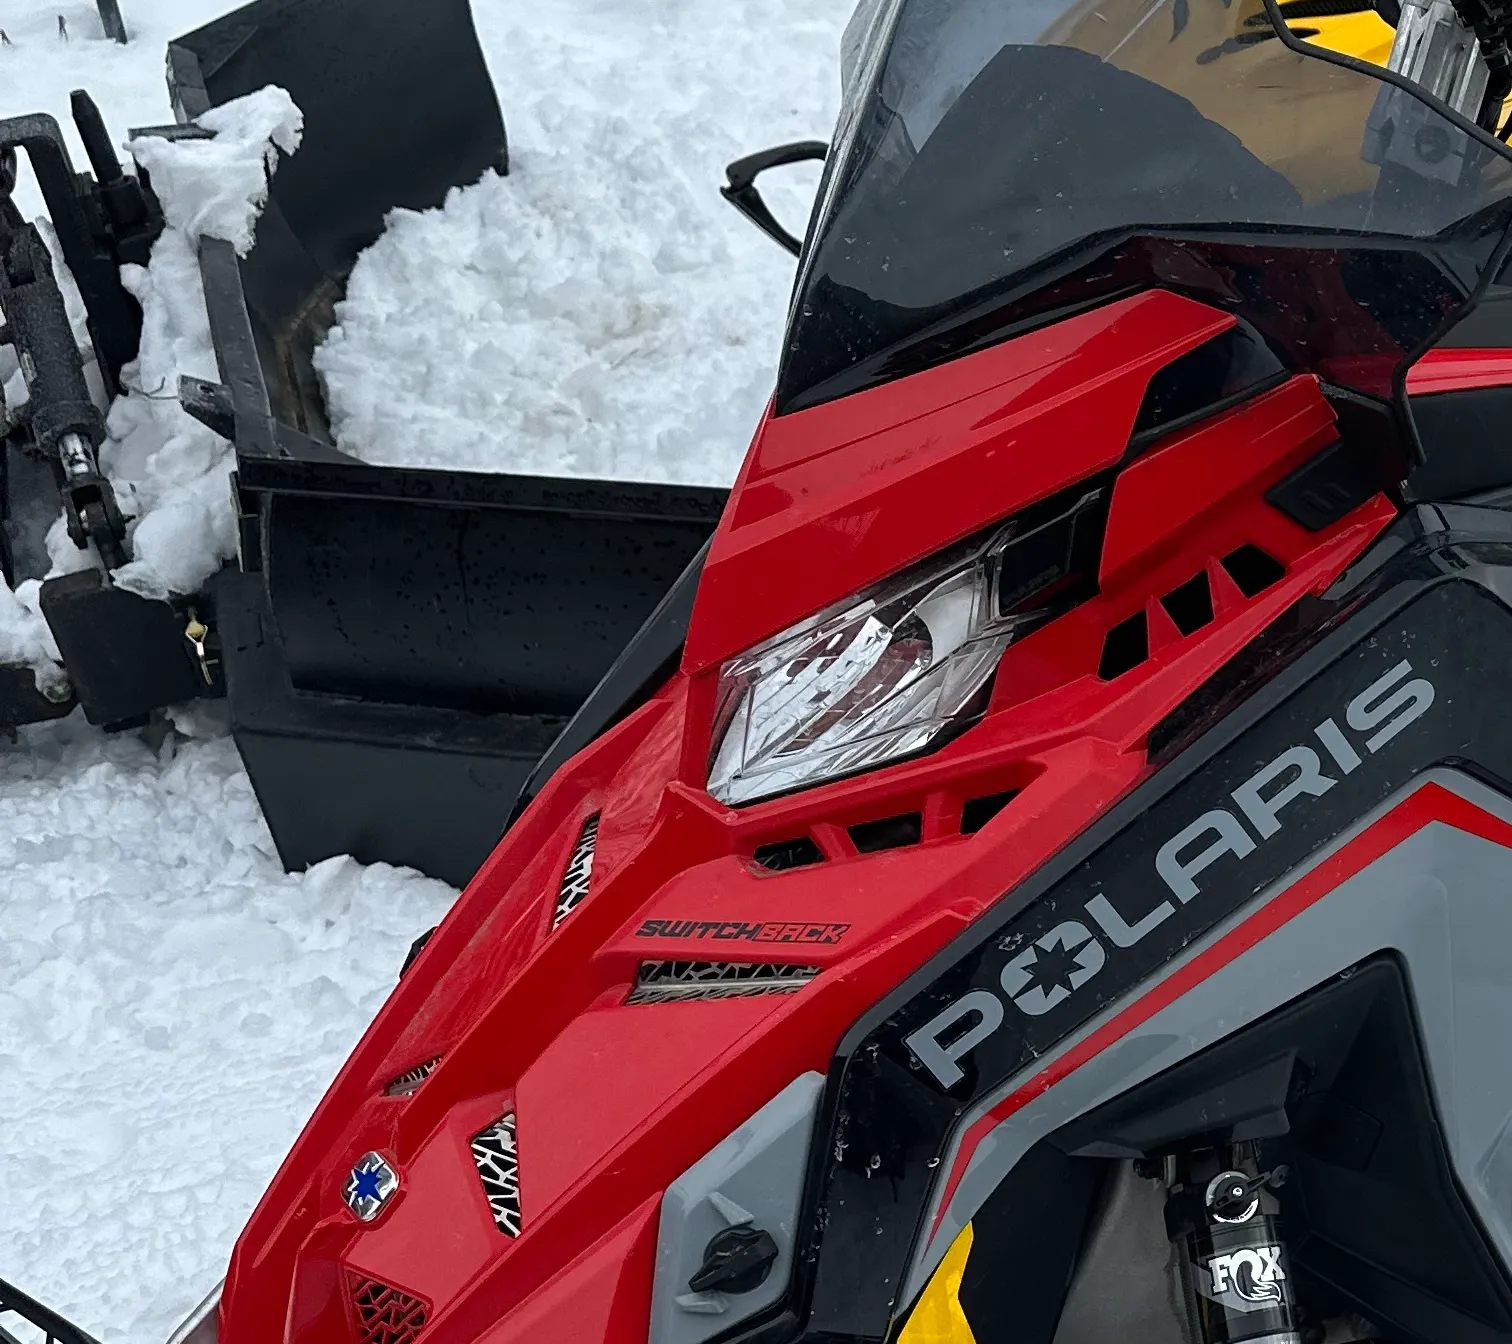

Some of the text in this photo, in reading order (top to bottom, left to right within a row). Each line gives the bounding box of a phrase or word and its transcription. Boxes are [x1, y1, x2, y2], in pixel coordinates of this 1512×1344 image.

[900, 658, 1437, 1090] POLARIS
[635, 919, 852, 944] SWITCHBACK
[1207, 1245, 1286, 1303] FOX
